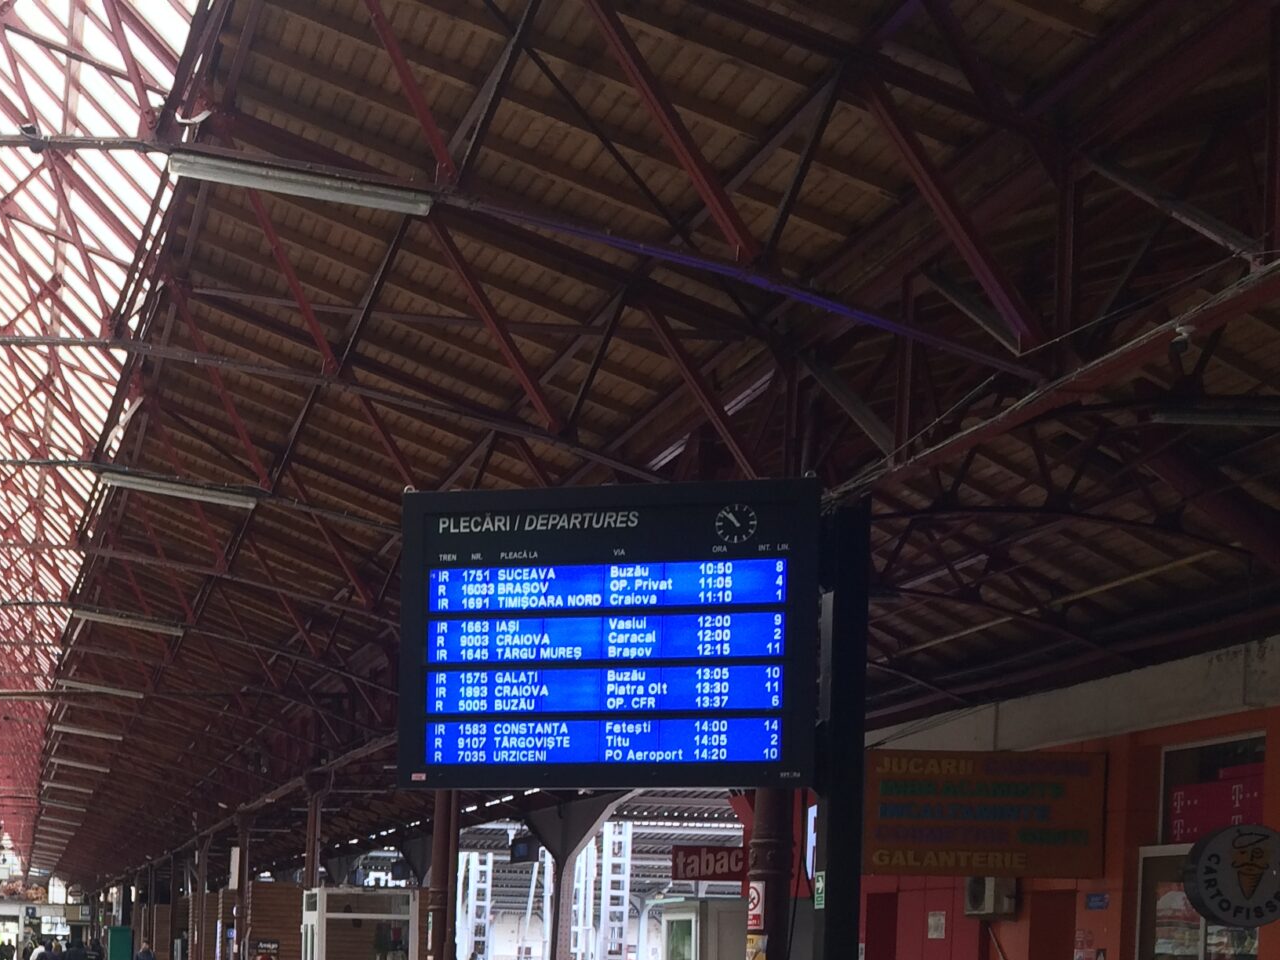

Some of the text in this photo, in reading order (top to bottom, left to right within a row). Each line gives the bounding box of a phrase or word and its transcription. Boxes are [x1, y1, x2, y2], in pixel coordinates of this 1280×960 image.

[439, 513, 510, 533] PLECĂRI
[524, 511, 639, 531] DEPARTURES
[439, 554, 457, 562] TREN
[712, 545, 727, 553] ORA
[438, 561, 783, 582] IR 1751 SUCEAVA Buzău 10:50 8
[438, 584, 446, 596] R
[461, 583, 494, 595] 16033
[610, 580, 631, 591] OP.
[635, 578, 673, 590] Privat
[699, 576, 732, 588] 11:05
[776, 575, 783, 586] 4
[438, 598, 448, 609] IR
[462, 597, 489, 608] 1691
[567, 594, 602, 606] NORD
[610, 593, 657, 605] Craiova
[699, 591, 732, 603] 11:10
[776, 590, 782, 600] 1
[437, 622, 448, 633] IR
[461, 621, 489, 632] 1663
[608, 617, 647, 629] Vaslui
[697, 615, 731, 627] 12:00
[774, 614, 782, 625] 9
[437, 628, 781, 647] R 9003 CRAIOVA Caracal 12:00 2
[436, 649, 447, 660] IR
[460, 648, 489, 660] 1645
[697, 643, 730, 655] 12:15
[767, 643, 780, 654] 11
[436, 673, 447, 684] IR
[460, 672, 488, 684] 1575
[607, 670, 645, 681] Buzău
[696, 668, 729, 680] 13:05
[765, 667, 780, 678] 10
[436, 681, 779, 698] IR 1893 CRAIOVA Piatra Olt 13:30 11
[436, 695, 779, 711] R 5005 BUZĂU OP. CFR 13:37 6
[435, 724, 445, 735] IR
[458, 723, 486, 734] 1583
[694, 720, 727, 732] 14:00
[764, 720, 778, 731] 14
[435, 738, 442, 749] R
[458, 737, 486, 748] 9107
[606, 736, 630, 747] Titu
[694, 734, 727, 746] 14:05
[770, 734, 778, 745] 2
[434, 748, 777, 762] R 7035 URZICENI PO Aeroport 14:20 10
[676, 848, 744, 878] tabac
[871, 849, 1028, 869] GALANTERIE
